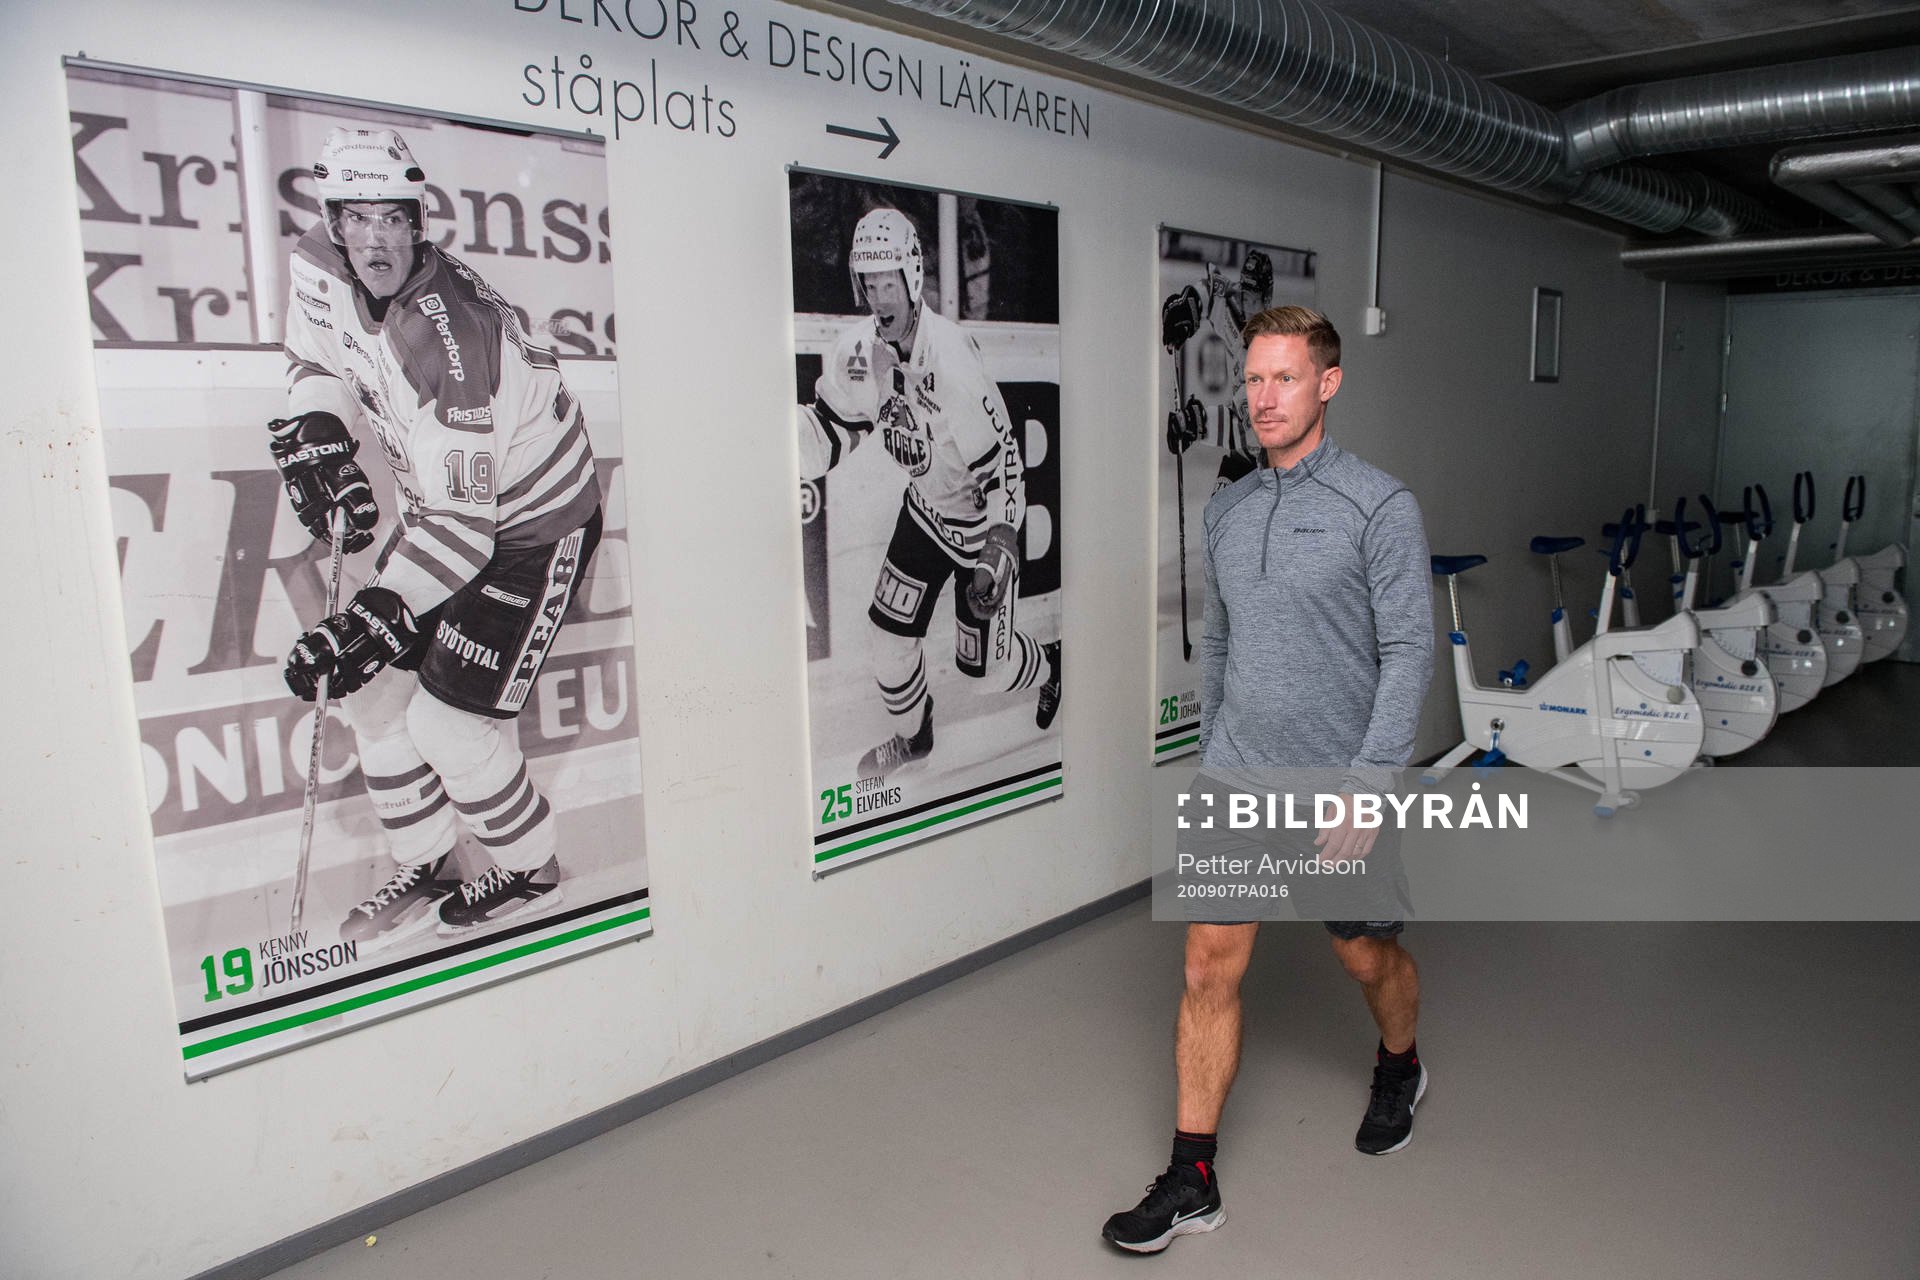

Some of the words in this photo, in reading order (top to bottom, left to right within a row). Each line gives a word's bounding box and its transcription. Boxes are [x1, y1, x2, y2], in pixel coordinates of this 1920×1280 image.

[514, 0, 700, 49] KOR
[720, 11, 749, 60] &
[768, 20, 922, 100] DESIGN
[940, 60, 1090, 139] LÄKTAREN
[522, 54, 736, 140] ståplats
[353, 170, 388, 182] Perstorp
[431, 313, 465, 382] Perstorp
[278, 443, 344, 468] EASTON
[444, 449, 497, 505] 19
[352, 603, 403, 654] EASTON
[436, 619, 500, 671] SYDTOTAL
[1160, 695, 1178, 725] 26
[1179, 701, 1201, 720] JOHAN
[1549, 705, 1588, 715] MONARK
[821, 783, 852, 824] 25
[856, 776, 885, 794] STEFAN
[857, 787, 901, 814] ELVENES
[259, 930, 309, 960] KENNY
[263, 940, 359, 988] JÖNSSON
[200, 947, 254, 1002] 19
